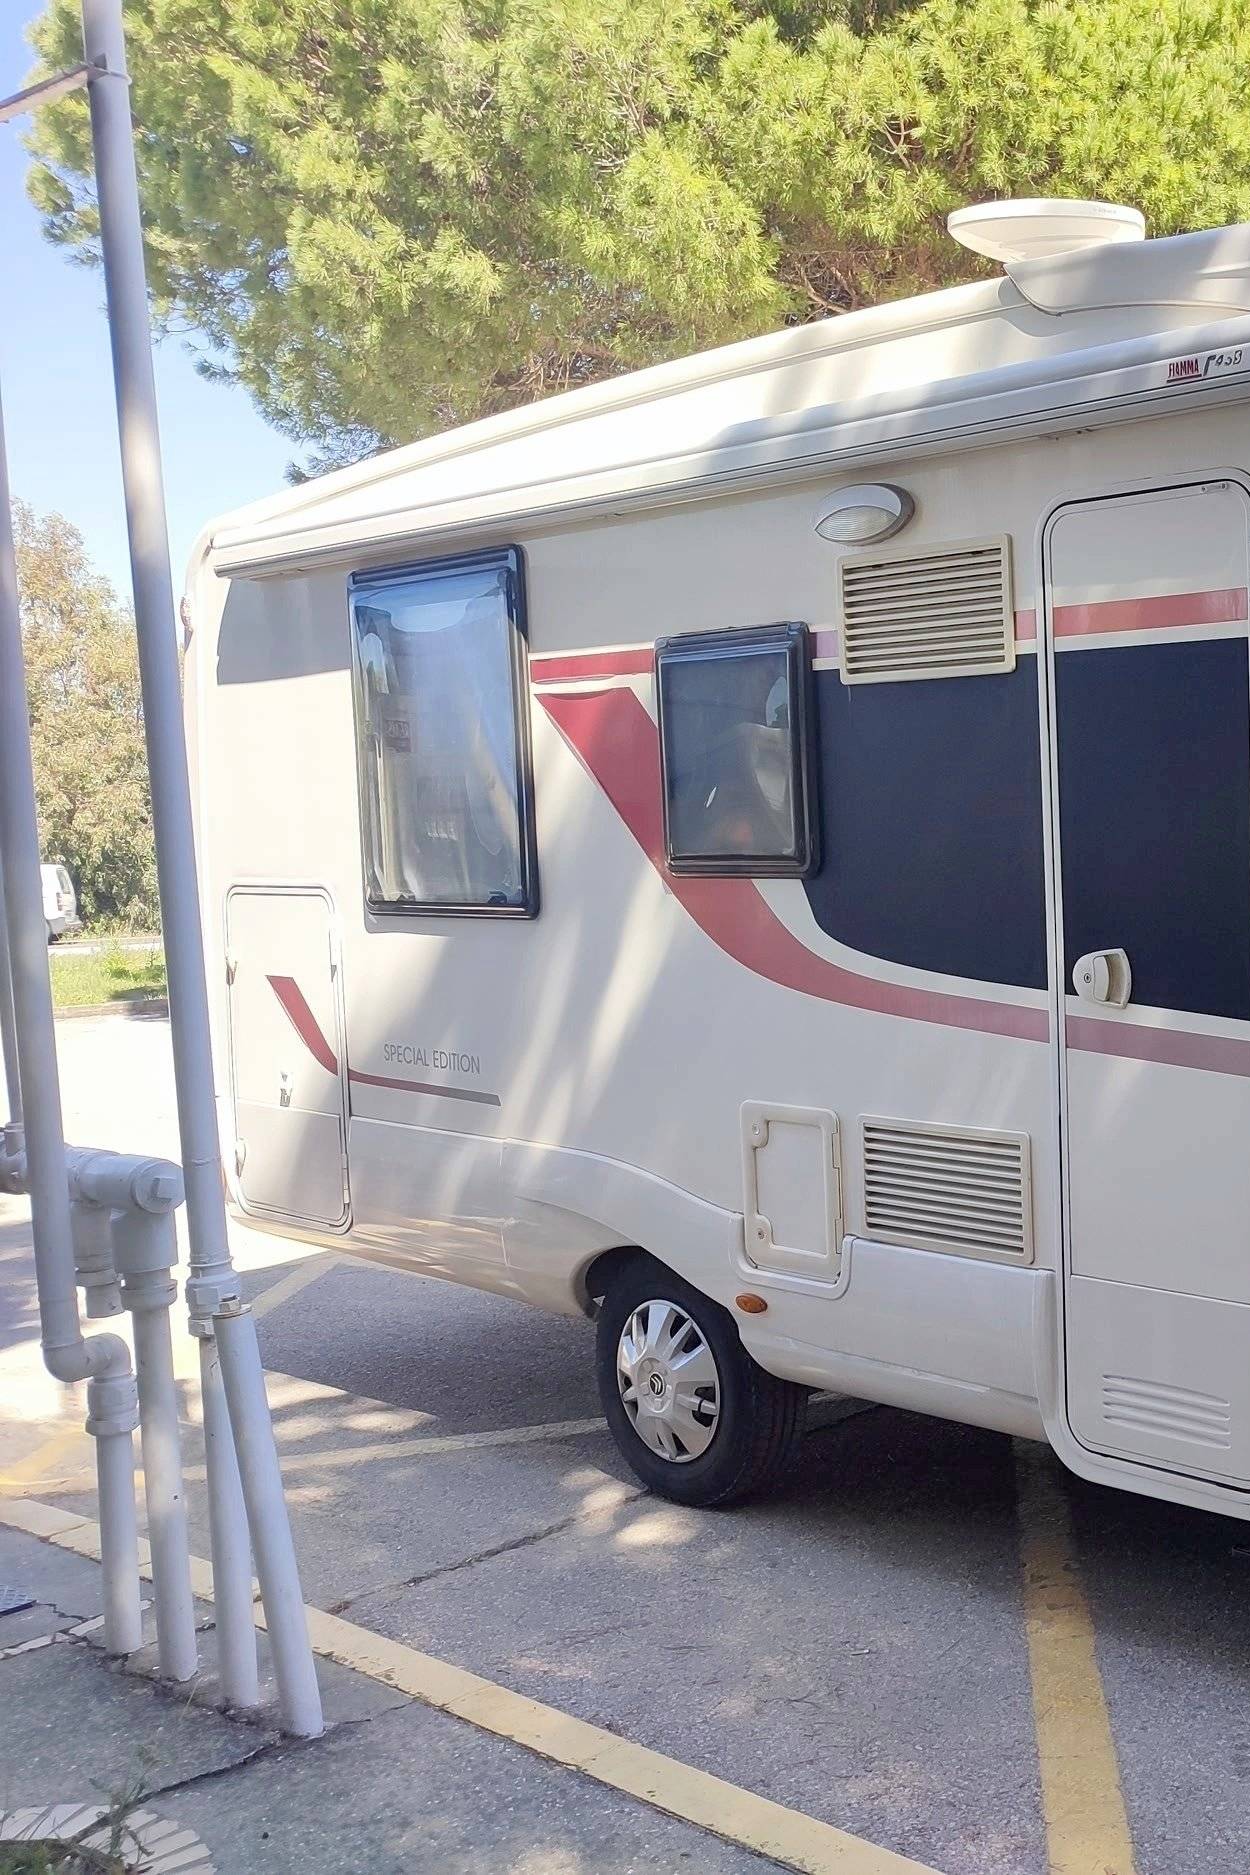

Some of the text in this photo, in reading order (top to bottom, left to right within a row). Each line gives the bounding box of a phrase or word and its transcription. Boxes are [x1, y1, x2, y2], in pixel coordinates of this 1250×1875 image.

[1168, 359, 1200, 378] FIAMMA
[383, 1043, 481, 1074] SPECIAL EDITION
